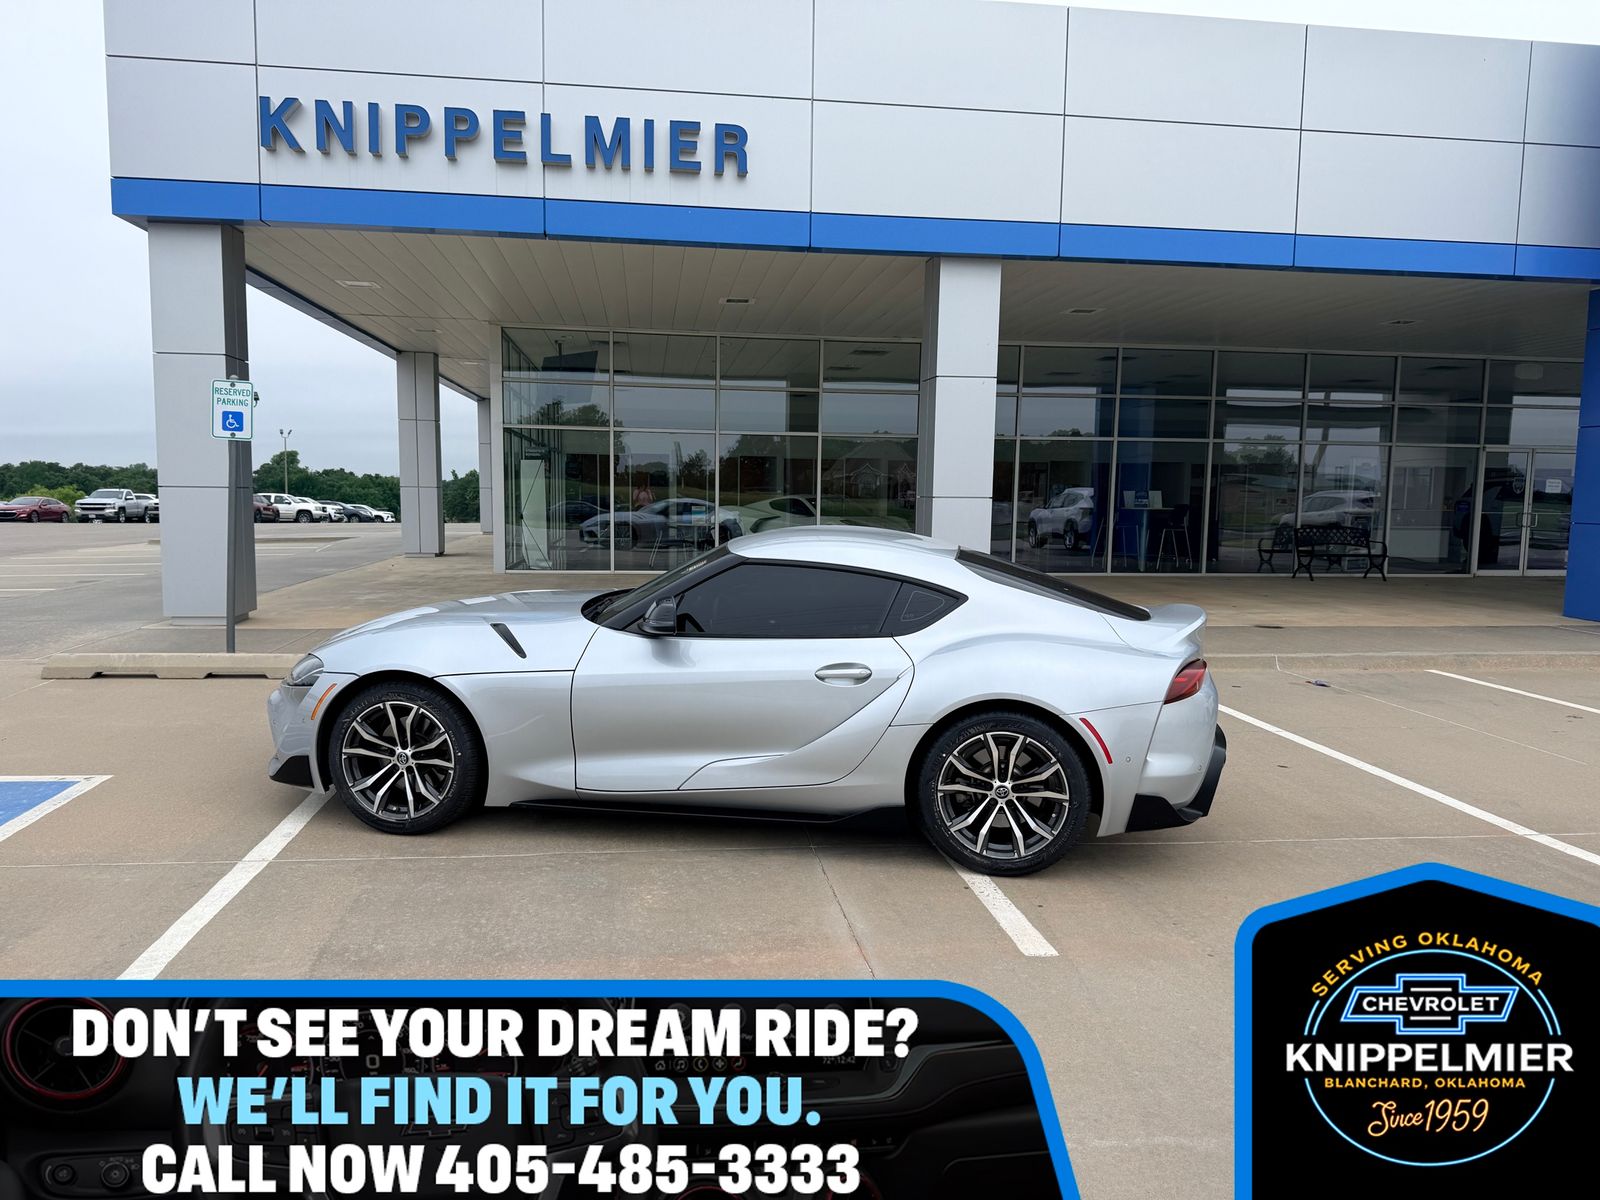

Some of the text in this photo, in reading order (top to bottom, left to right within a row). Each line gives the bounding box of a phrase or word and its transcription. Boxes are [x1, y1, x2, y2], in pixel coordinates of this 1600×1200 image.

[258, 95, 749, 177] KNIPPELMIER
[214, 387, 251, 397] RESERVED
[216, 397, 249, 407] PARKING
